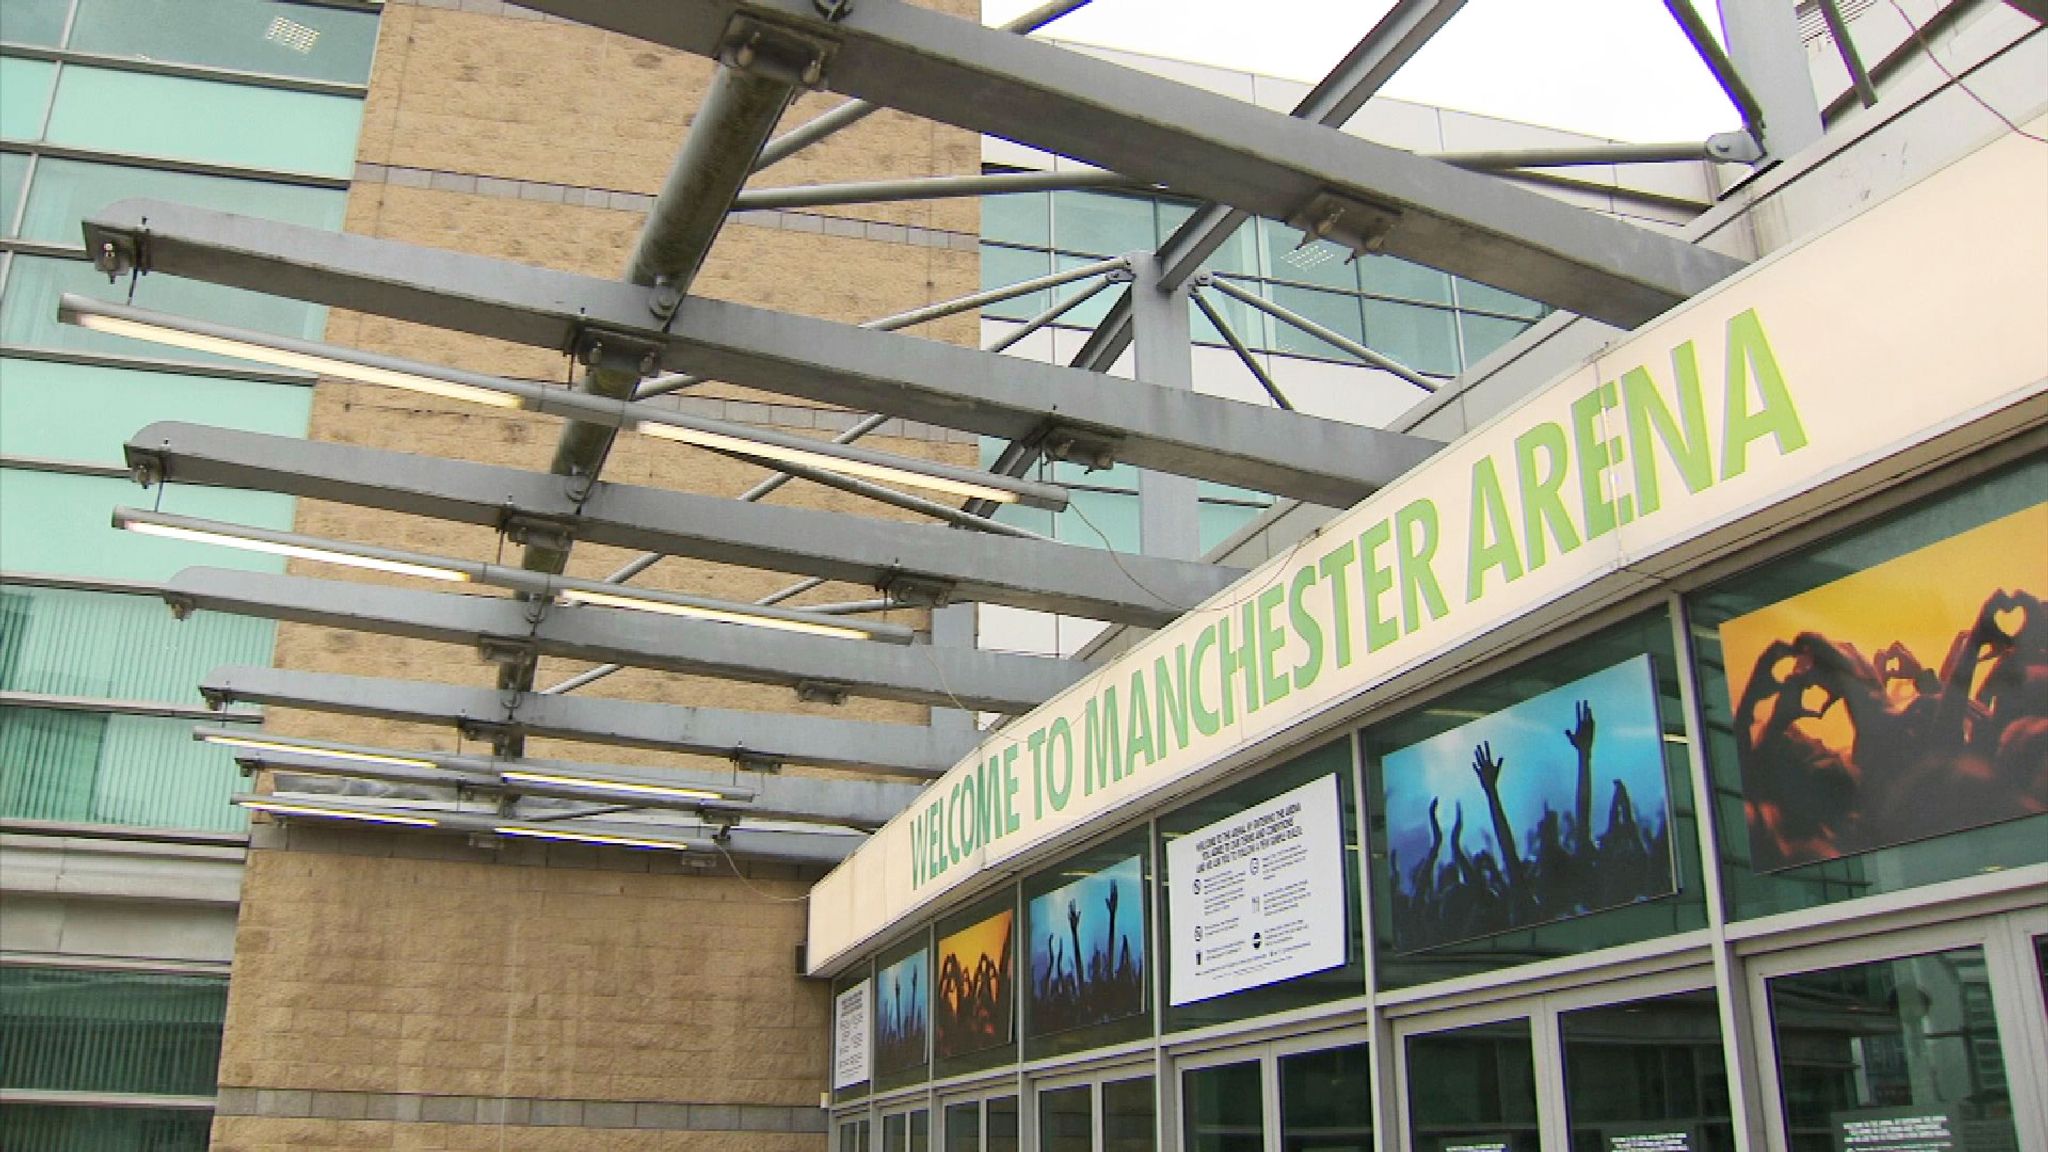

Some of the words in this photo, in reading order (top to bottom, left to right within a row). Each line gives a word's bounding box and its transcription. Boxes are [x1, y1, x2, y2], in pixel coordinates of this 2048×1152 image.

[910, 742, 1020, 891] WELCOME
[1027, 715, 1074, 821] TO
[1084, 496, 1449, 797] MANCHESTER
[1466, 307, 1809, 604] ARENA
